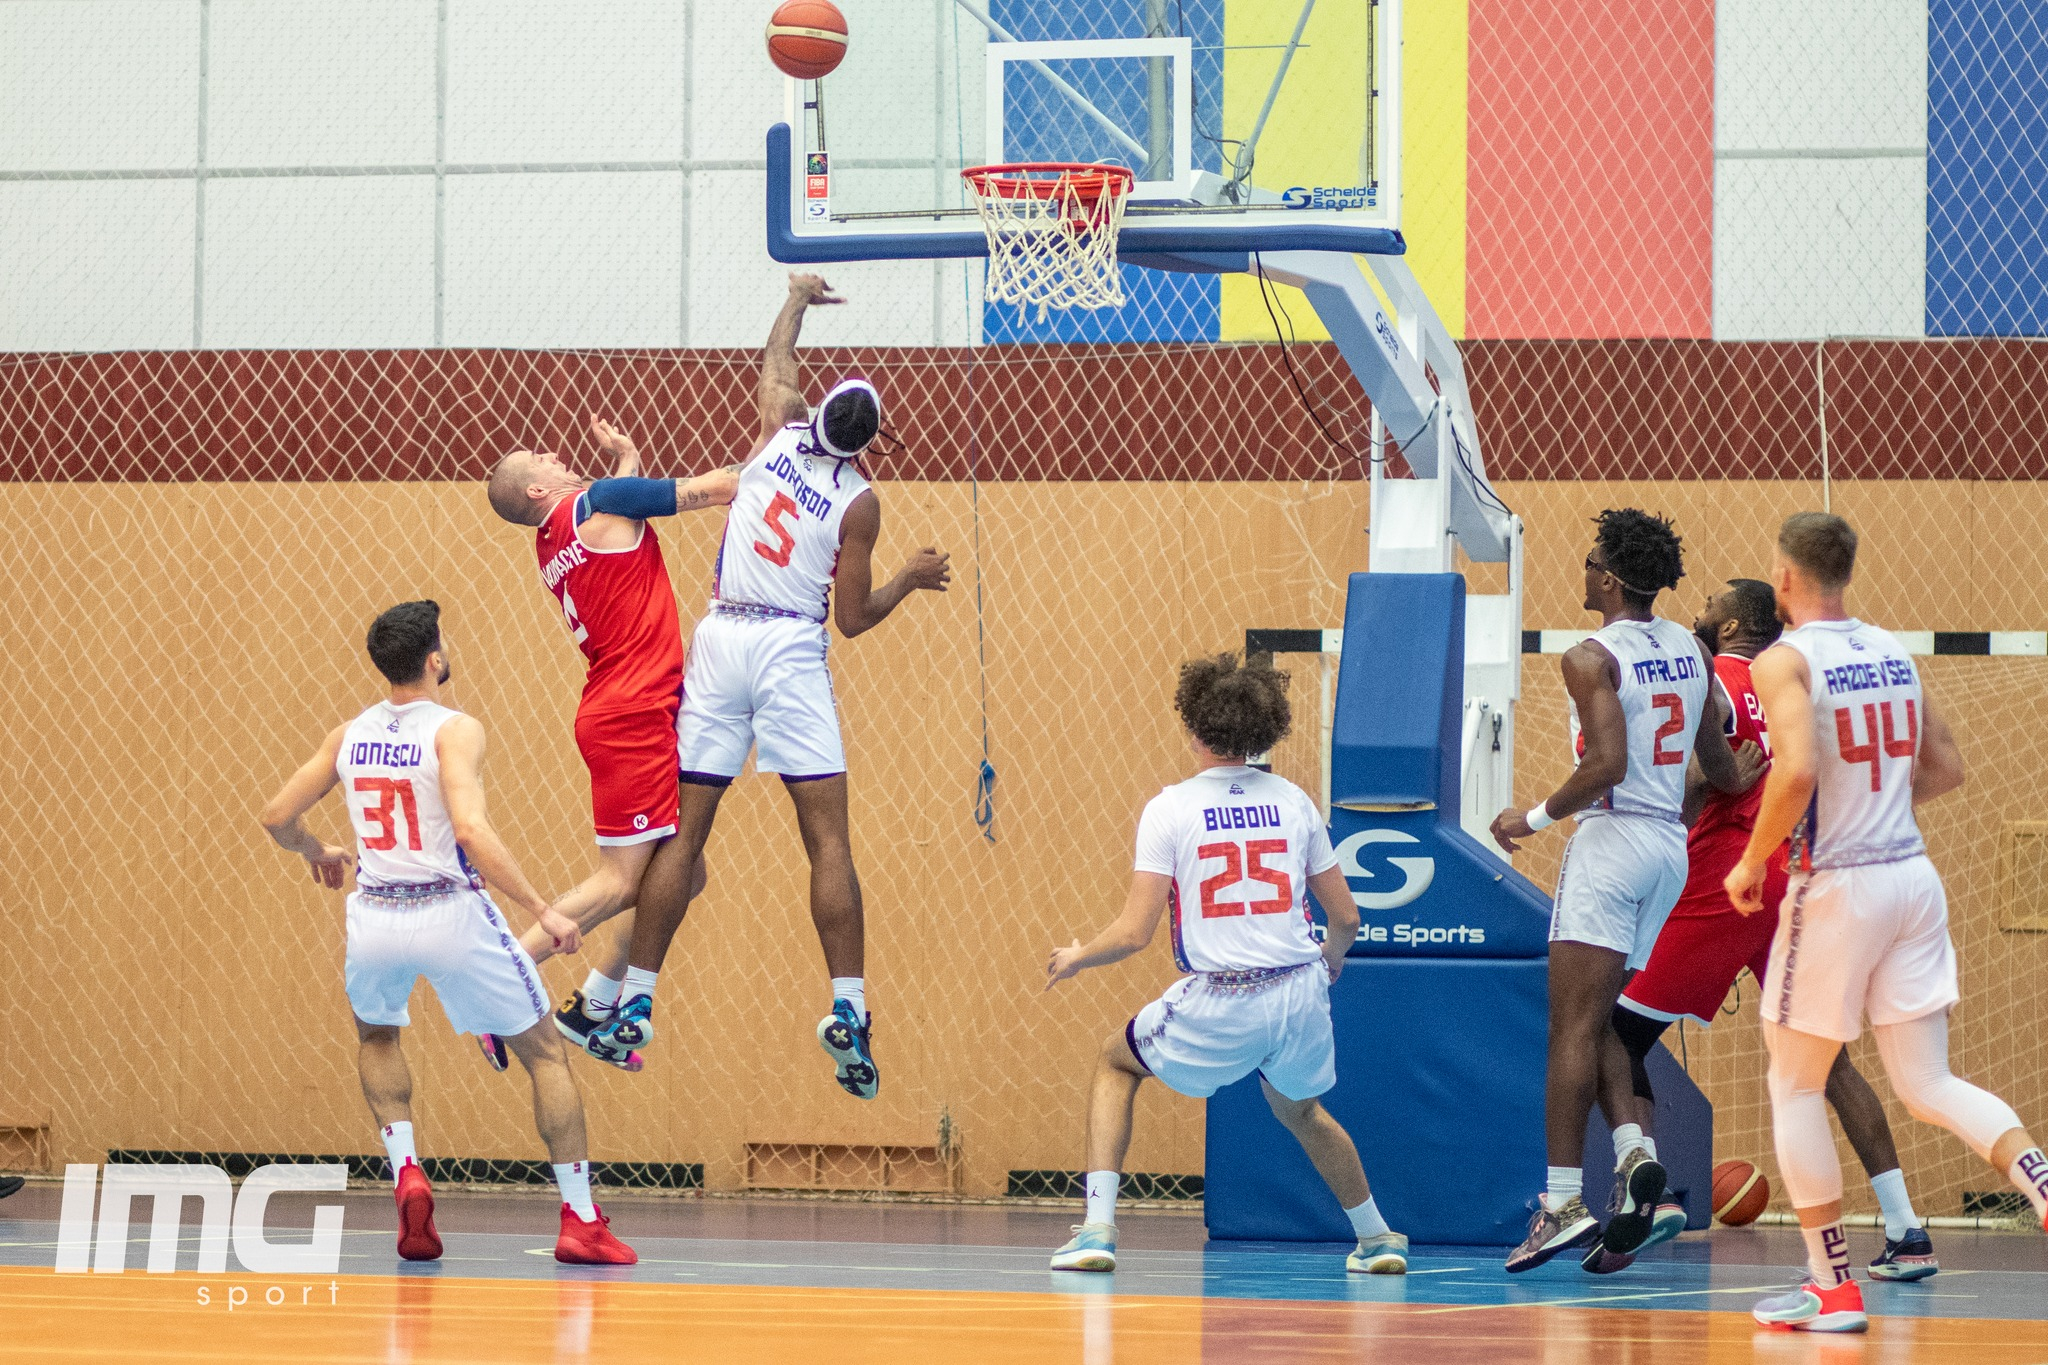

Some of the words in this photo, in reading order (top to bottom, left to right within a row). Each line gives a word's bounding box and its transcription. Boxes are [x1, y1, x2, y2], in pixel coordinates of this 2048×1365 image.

[1313, 187, 1377, 197] Schelde
[1313, 197, 1377, 210] Sports
[753, 490, 800, 568] 5
[1632, 655, 1699, 685] MARLON
[1651, 692, 1685, 766] 2
[350, 742, 422, 768] IONESCU
[1834, 699, 1918, 793] 44
[353, 777, 423, 851] 31
[1203, 805, 1281, 832] BUBOIU
[1197, 838, 1293, 919] 25
[1393, 924, 1485, 947] Sports
